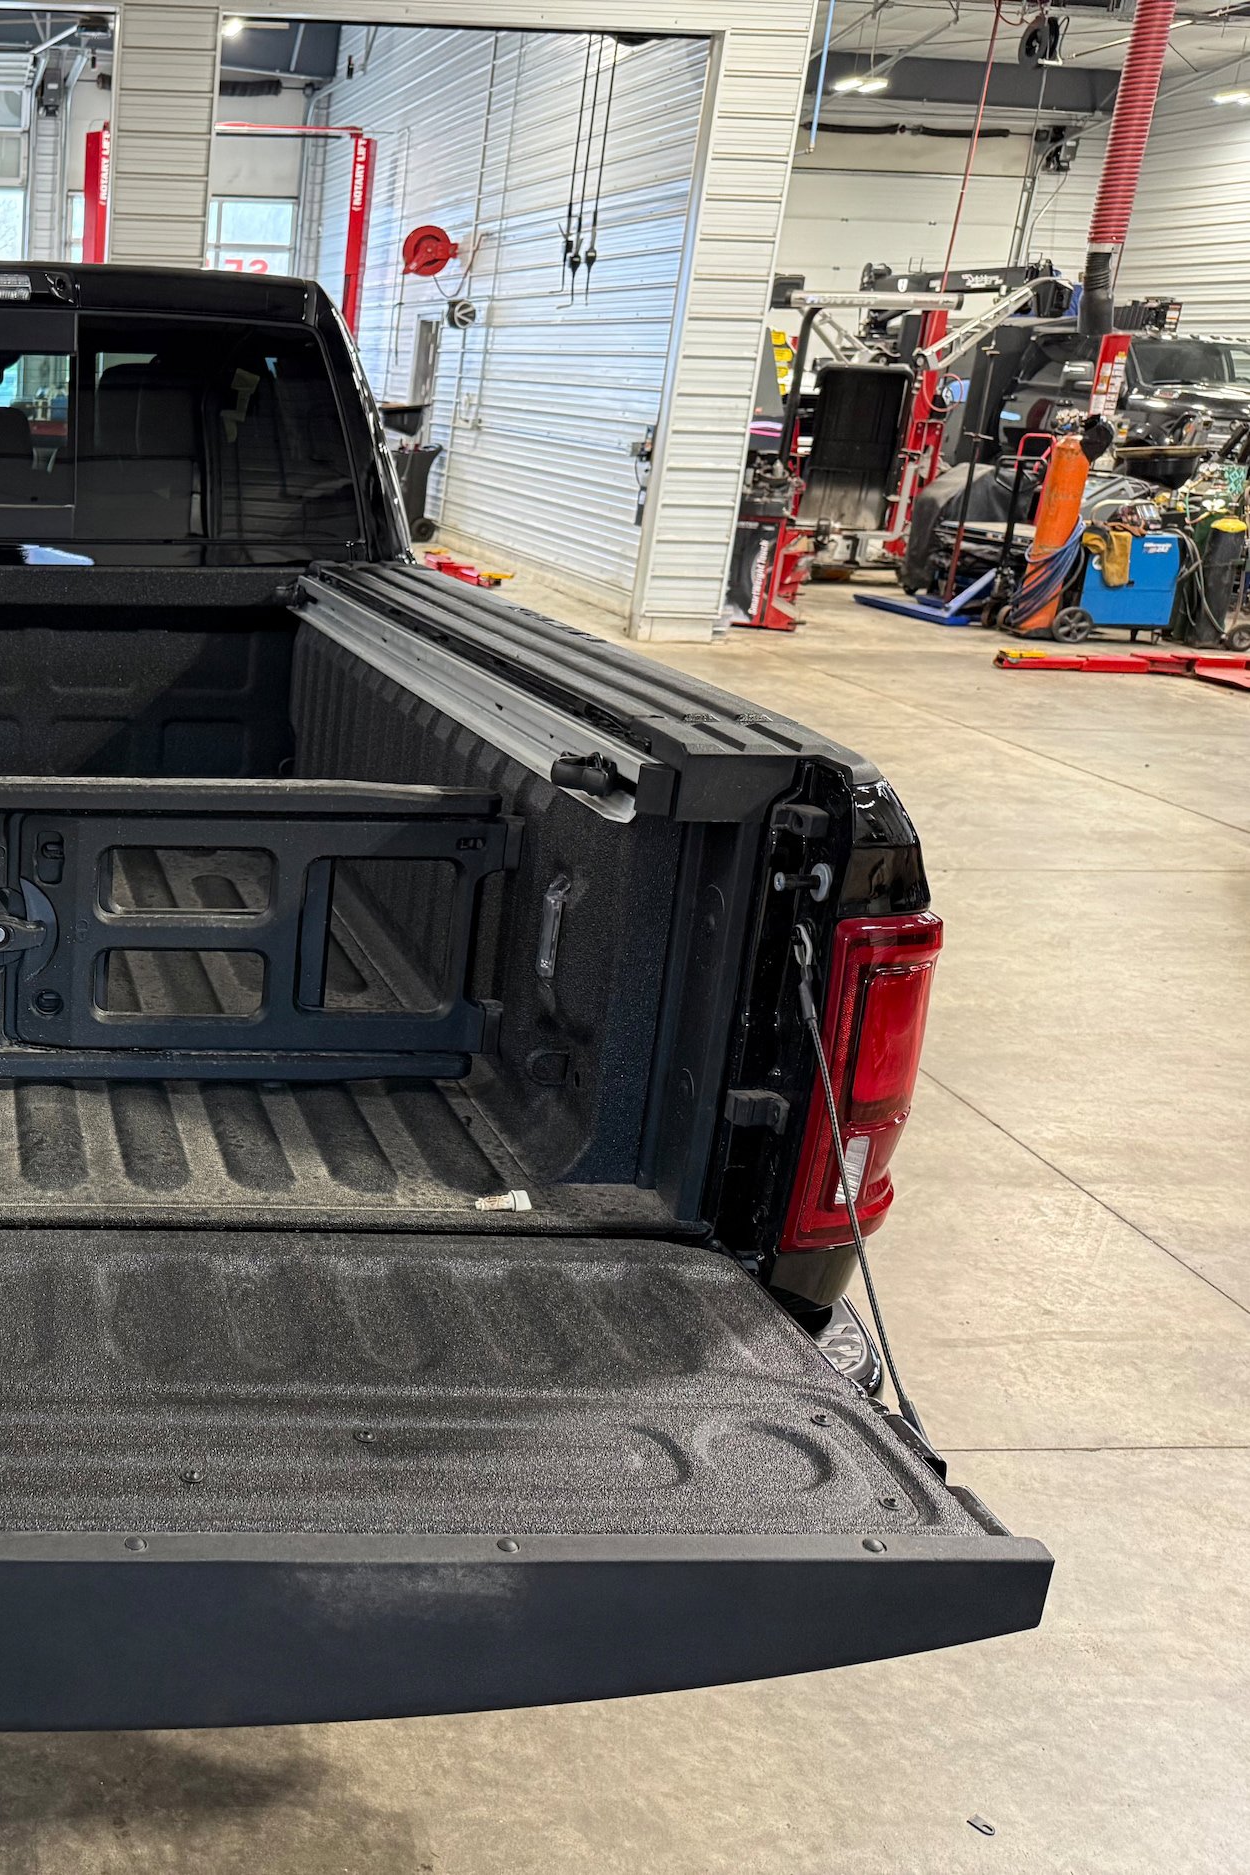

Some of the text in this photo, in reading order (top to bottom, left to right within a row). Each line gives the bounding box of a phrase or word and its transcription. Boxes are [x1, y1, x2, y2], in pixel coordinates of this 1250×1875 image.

[99, 157, 110, 201] ROTARY
[352, 138, 367, 206] ROTARY LIFT
